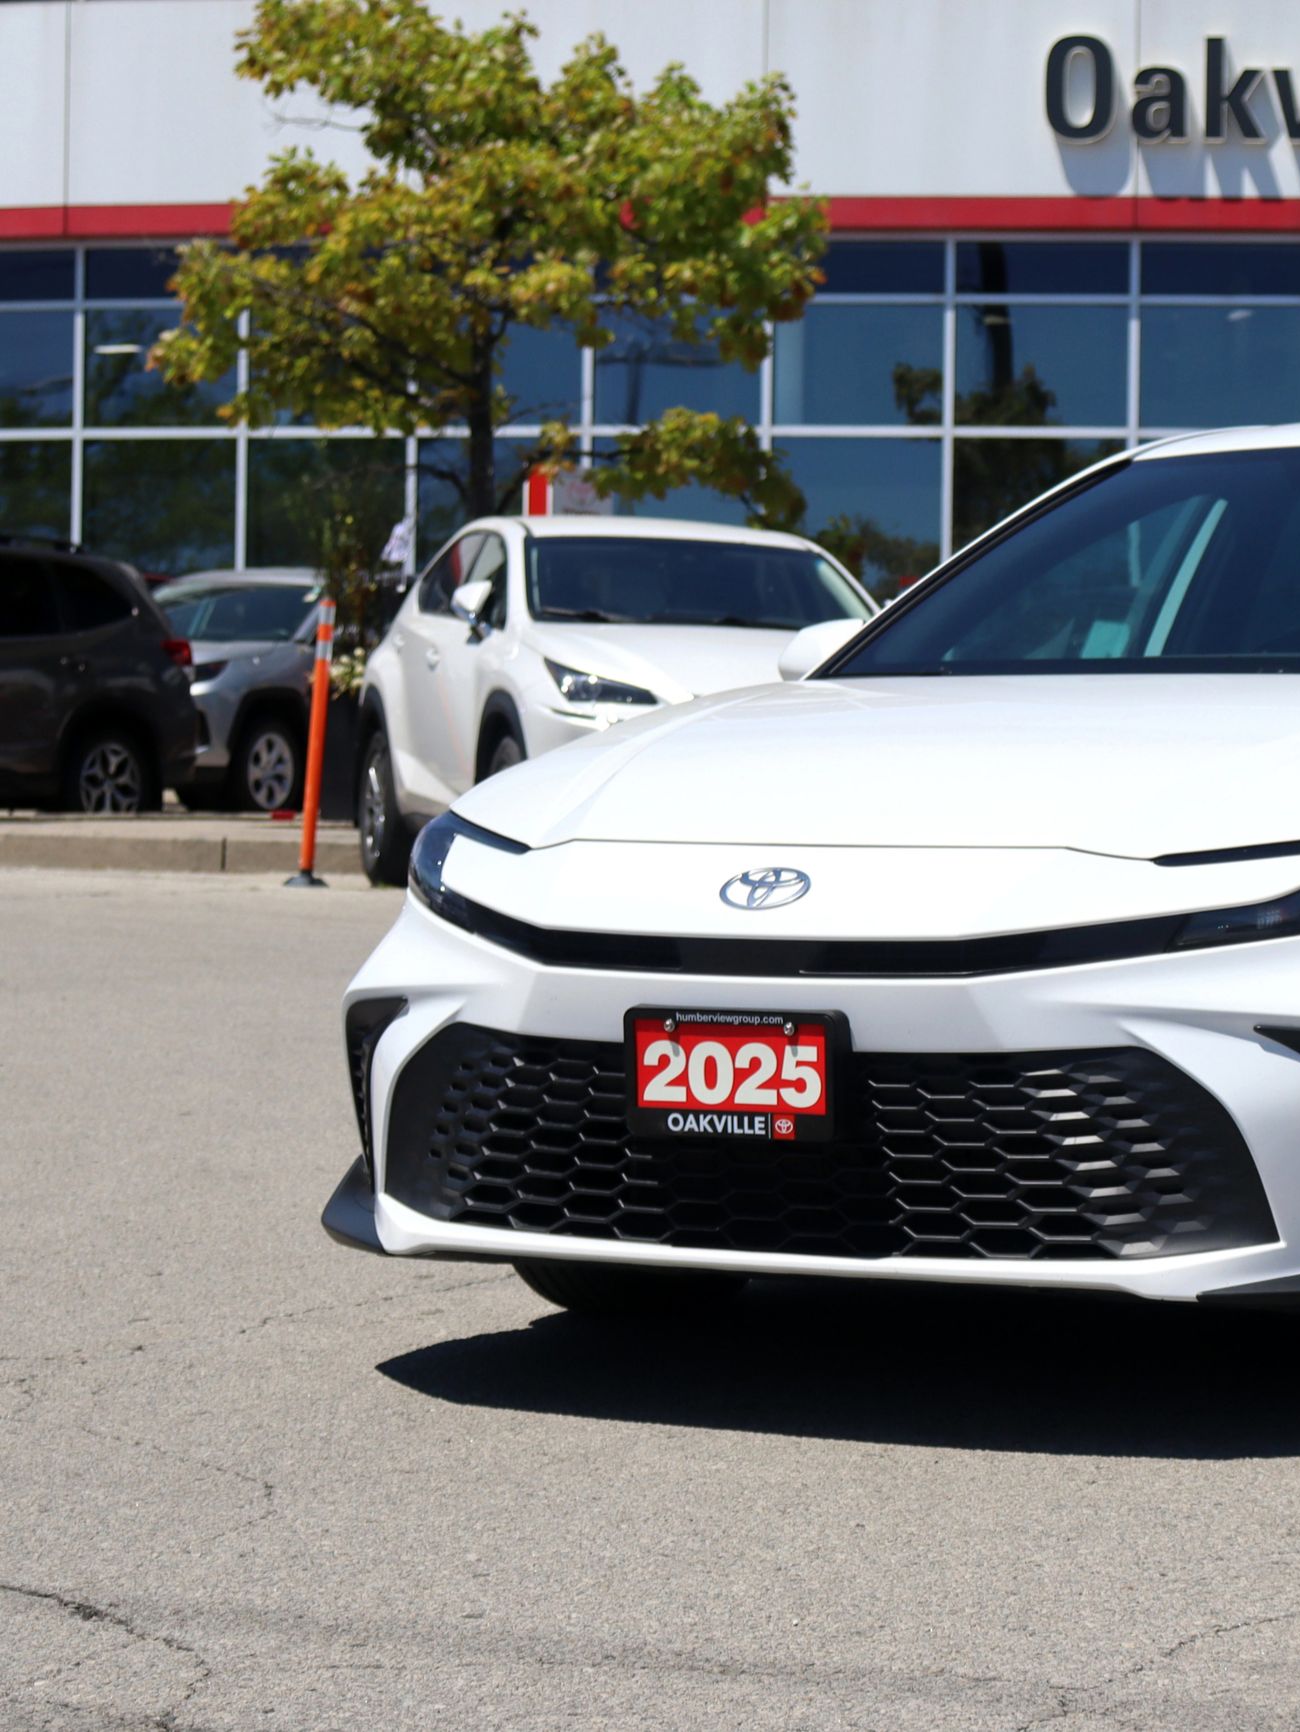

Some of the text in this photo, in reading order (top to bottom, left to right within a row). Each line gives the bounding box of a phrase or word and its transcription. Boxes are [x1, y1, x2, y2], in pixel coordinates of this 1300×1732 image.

[675, 1012, 784, 1026] humberviewgroup.com
[643, 1039, 822, 1108] 2025
[667, 1112, 766, 1136] OAKVILLE
